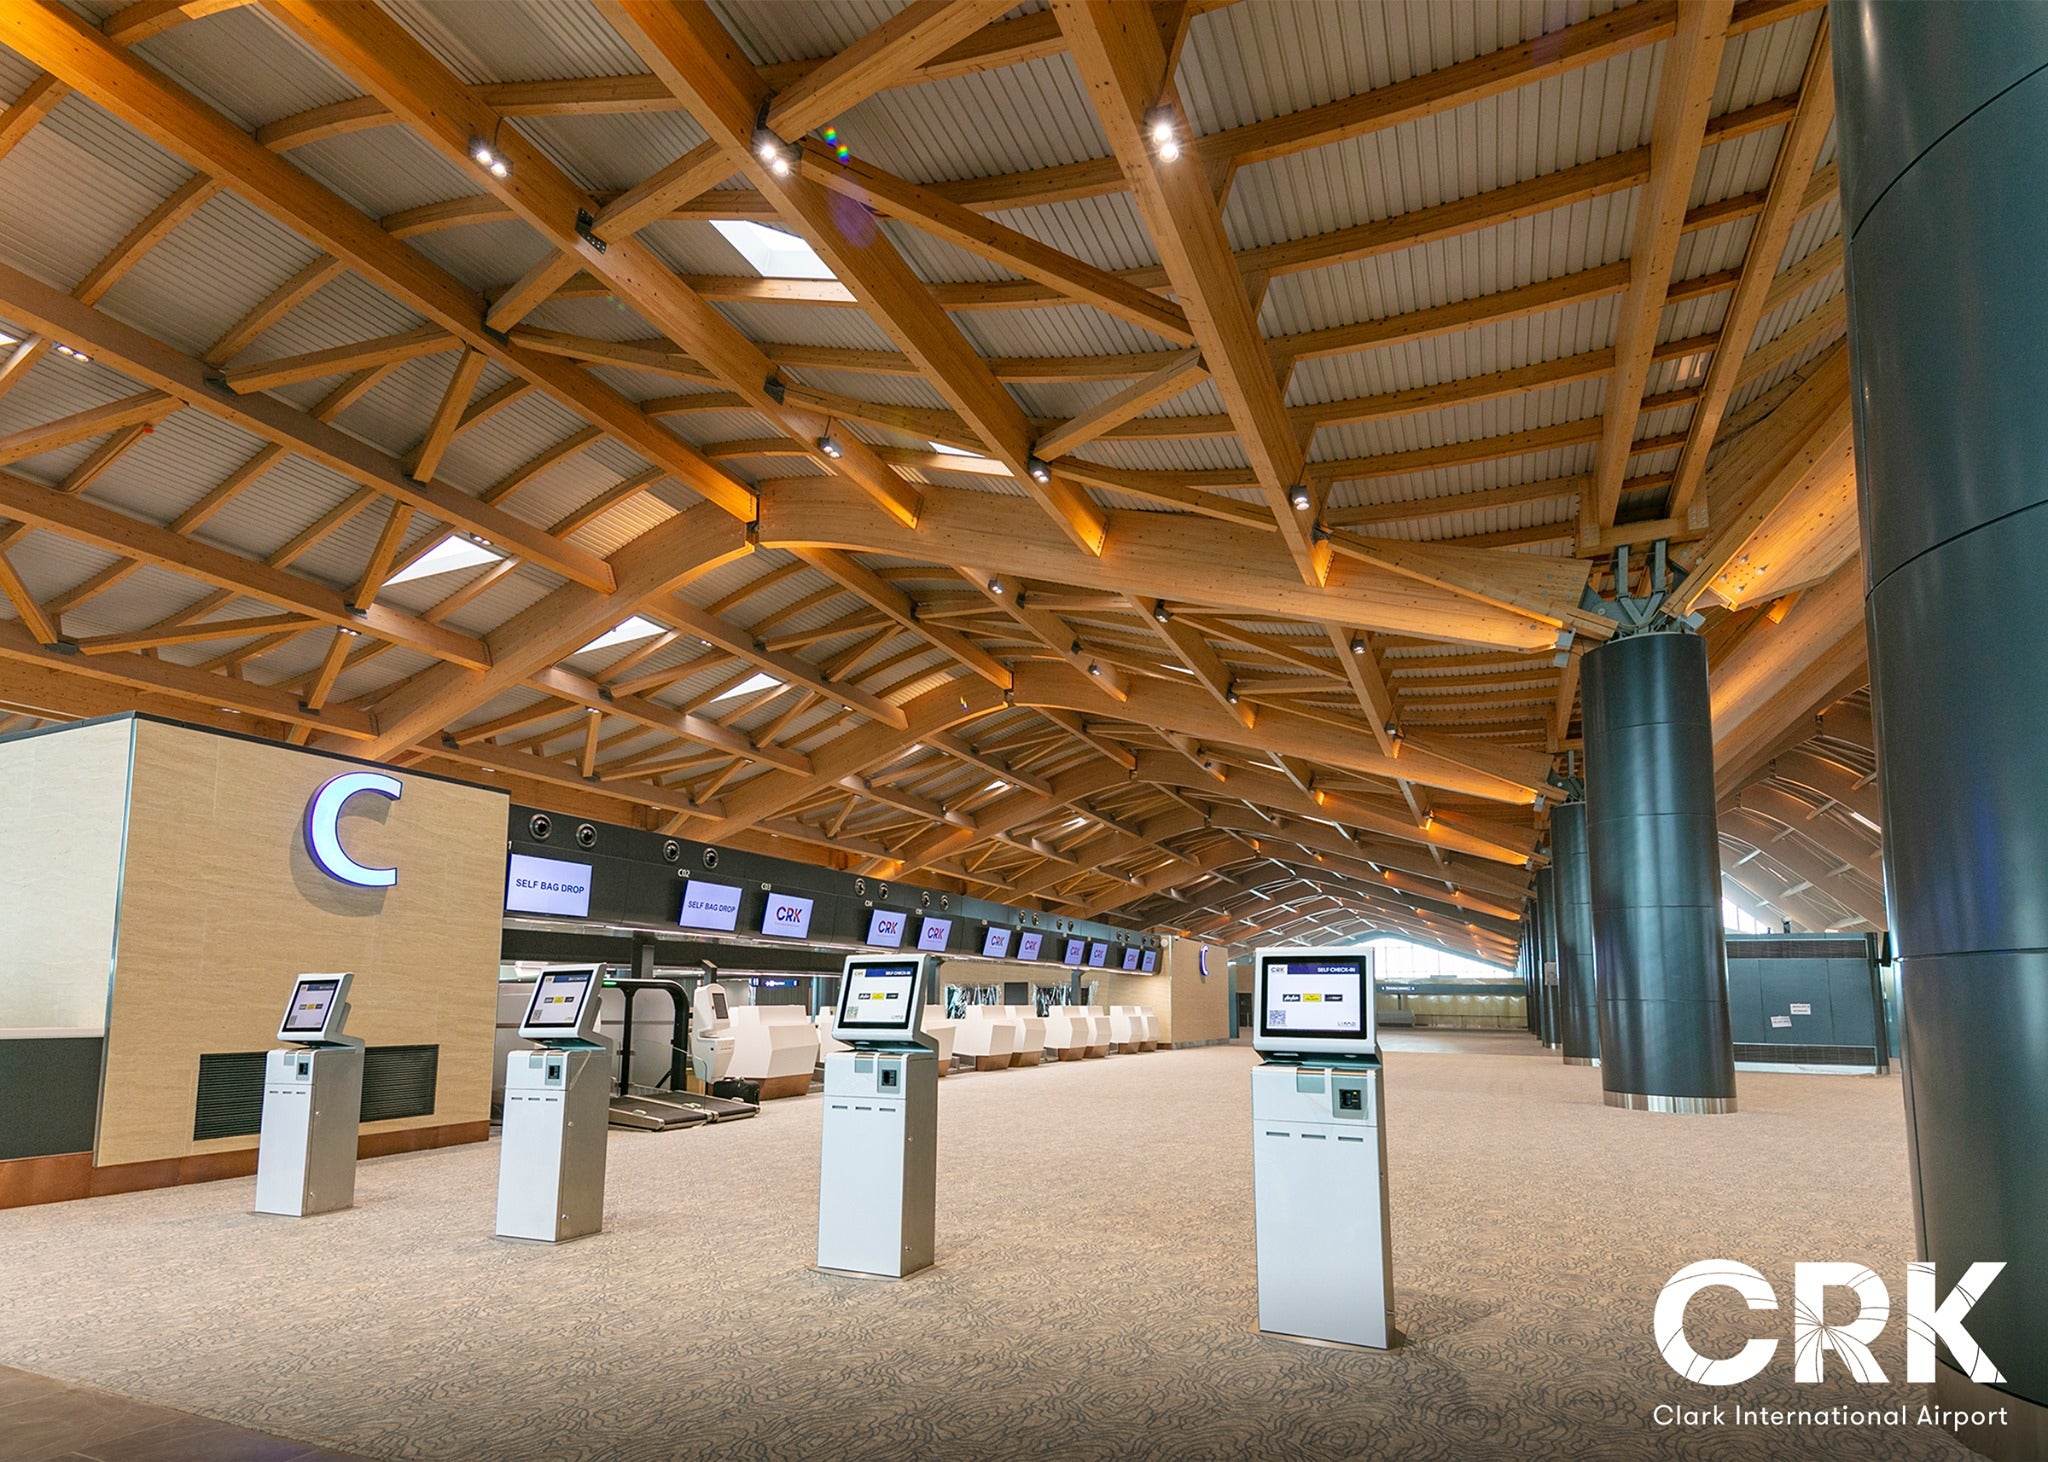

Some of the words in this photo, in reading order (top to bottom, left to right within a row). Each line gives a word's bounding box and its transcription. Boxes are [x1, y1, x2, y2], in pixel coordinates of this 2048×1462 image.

[303, 771, 403, 888] C
[677, 868, 691, 878] C02
[515, 878, 539, 889] SELF
[540, 881, 559, 892] BAG
[561, 883, 585, 894] DROP
[687, 900, 704, 909] SELF
[704, 902, 718, 911] BAG
[718, 904, 736, 913] DROP
[776, 905, 802, 923] CRK
[878, 920, 898, 935] CRK
[927, 926, 945, 940] CRK
